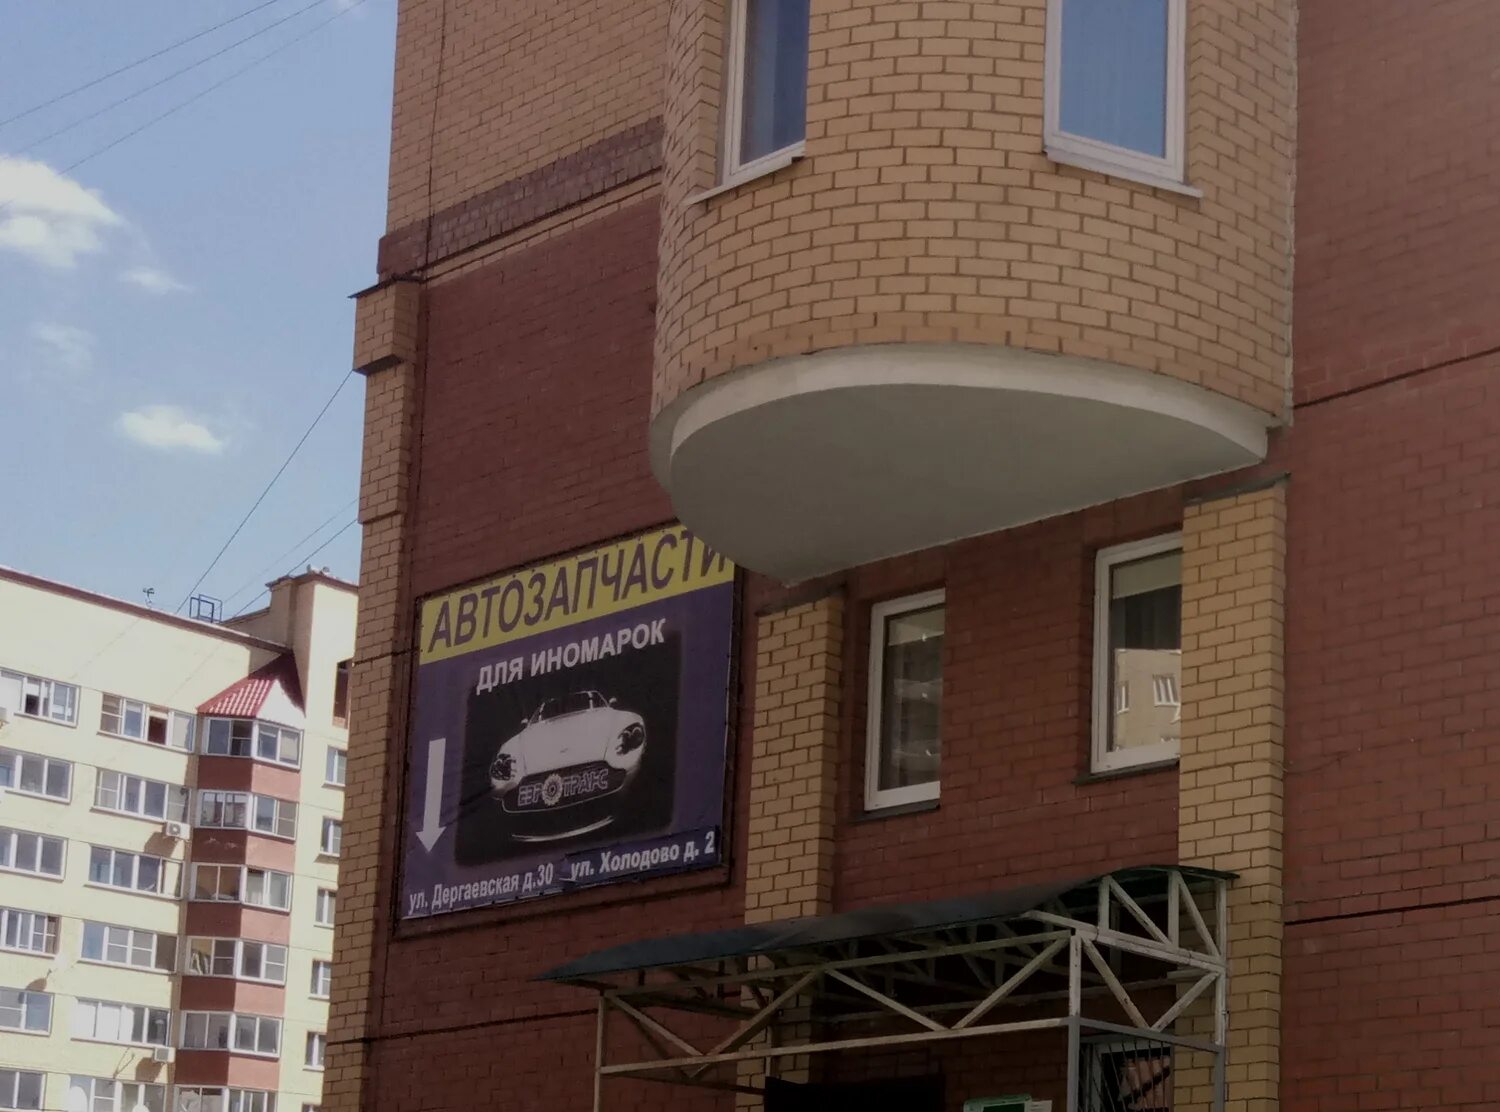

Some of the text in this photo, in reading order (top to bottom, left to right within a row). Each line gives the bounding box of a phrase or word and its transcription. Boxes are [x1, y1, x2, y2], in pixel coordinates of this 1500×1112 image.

[476, 618, 666, 695] ДЛЯ ИНОМАРОК
[408, 889, 429, 915] ул.
[431, 876, 519, 910] Дергаевская
[570, 859, 594, 881] ул.
[599, 840, 680, 874] Холодово
[683, 839, 700, 863] д.
[703, 831, 716, 854] 2
